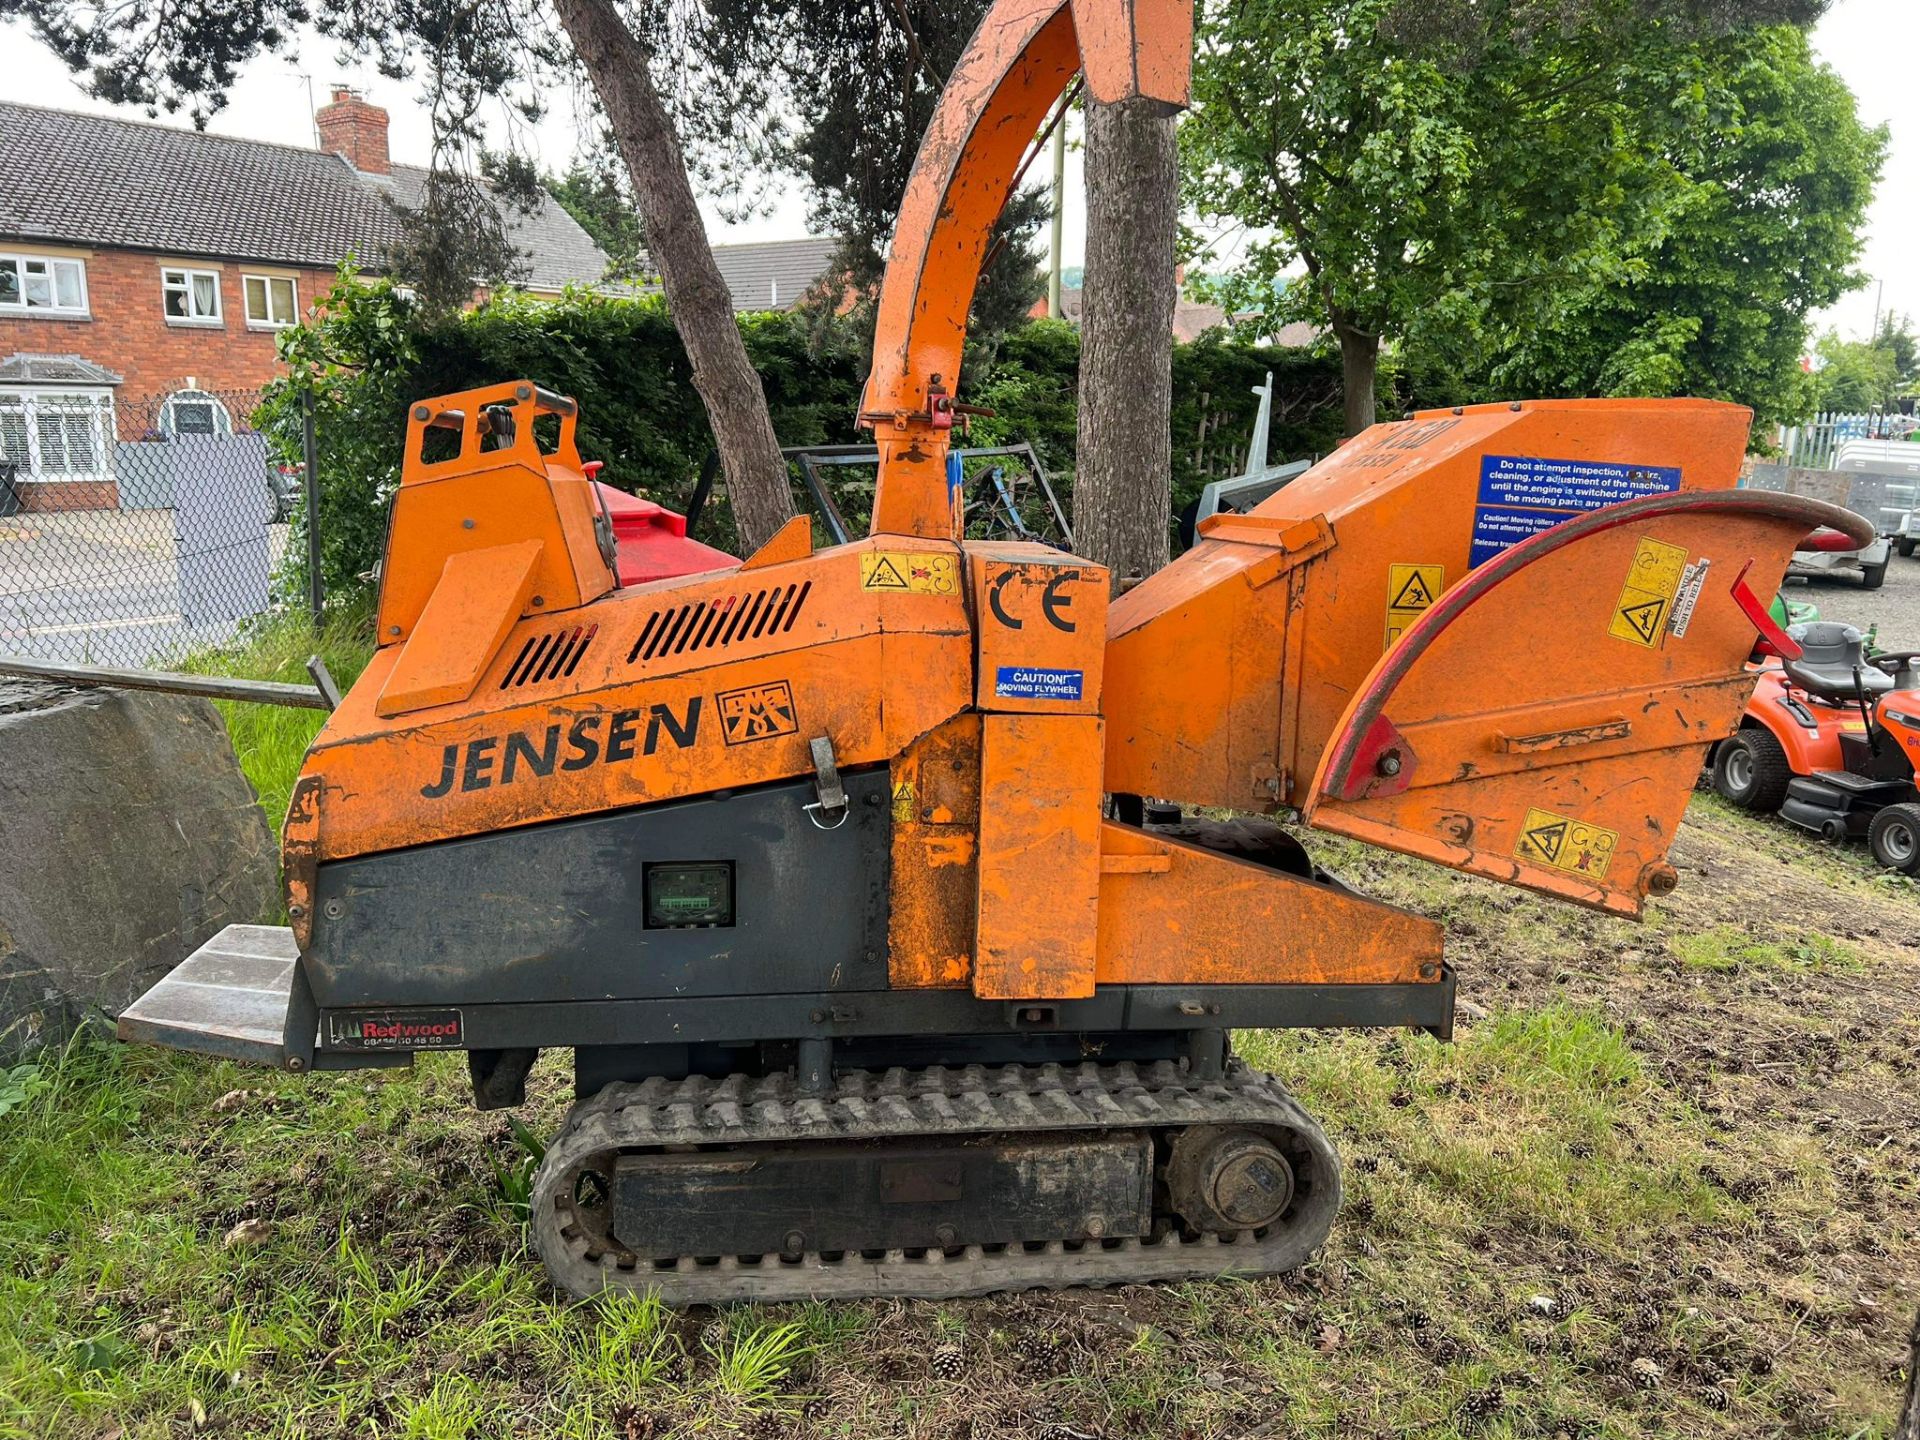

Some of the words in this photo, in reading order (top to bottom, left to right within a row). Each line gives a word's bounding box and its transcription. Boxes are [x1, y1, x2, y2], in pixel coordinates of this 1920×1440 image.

[1500, 460, 1514, 469] Do
[1516, 461, 1531, 471] not
[1534, 463, 1571, 474] attempt
[1573, 465, 1624, 478] inspection,
[1489, 471, 1531, 482] cleaning,
[1534, 474, 1544, 482] or
[1546, 474, 1599, 486] adjustment
[1601, 478, 1612, 487] of
[1613, 479, 1627, 488] the
[1629, 481, 1670, 491] machine
[1491, 482, 1511, 490] until
[1514, 483, 1529, 491] the
[1531, 486, 1562, 495] engine
[1565, 486, 1573, 494] is
[1575, 488, 1617, 498] switched
[1619, 490, 1633, 499] off
[1504, 494, 1520, 502] the
[1522, 495, 1556, 505] moving
[1558, 498, 1583, 507] parts
[1483, 513, 1509, 522] Caution!
[1510, 516, 1533, 525] Moving
[1534, 518, 1554, 526] rollers
[1500, 524, 1524, 533] attempt
[1474, 538, 1499, 547] Release
[1676, 613, 1689, 636] PUSH
[1685, 600, 1694, 612] TO
[1013, 672, 1067, 685] CAUTION!
[999, 682, 1033, 692] MOVING
[1034, 684, 1079, 695] FLYWHEEL
[420, 696, 702, 798] JENSEN
[362, 1020, 458, 1038] Redwood
